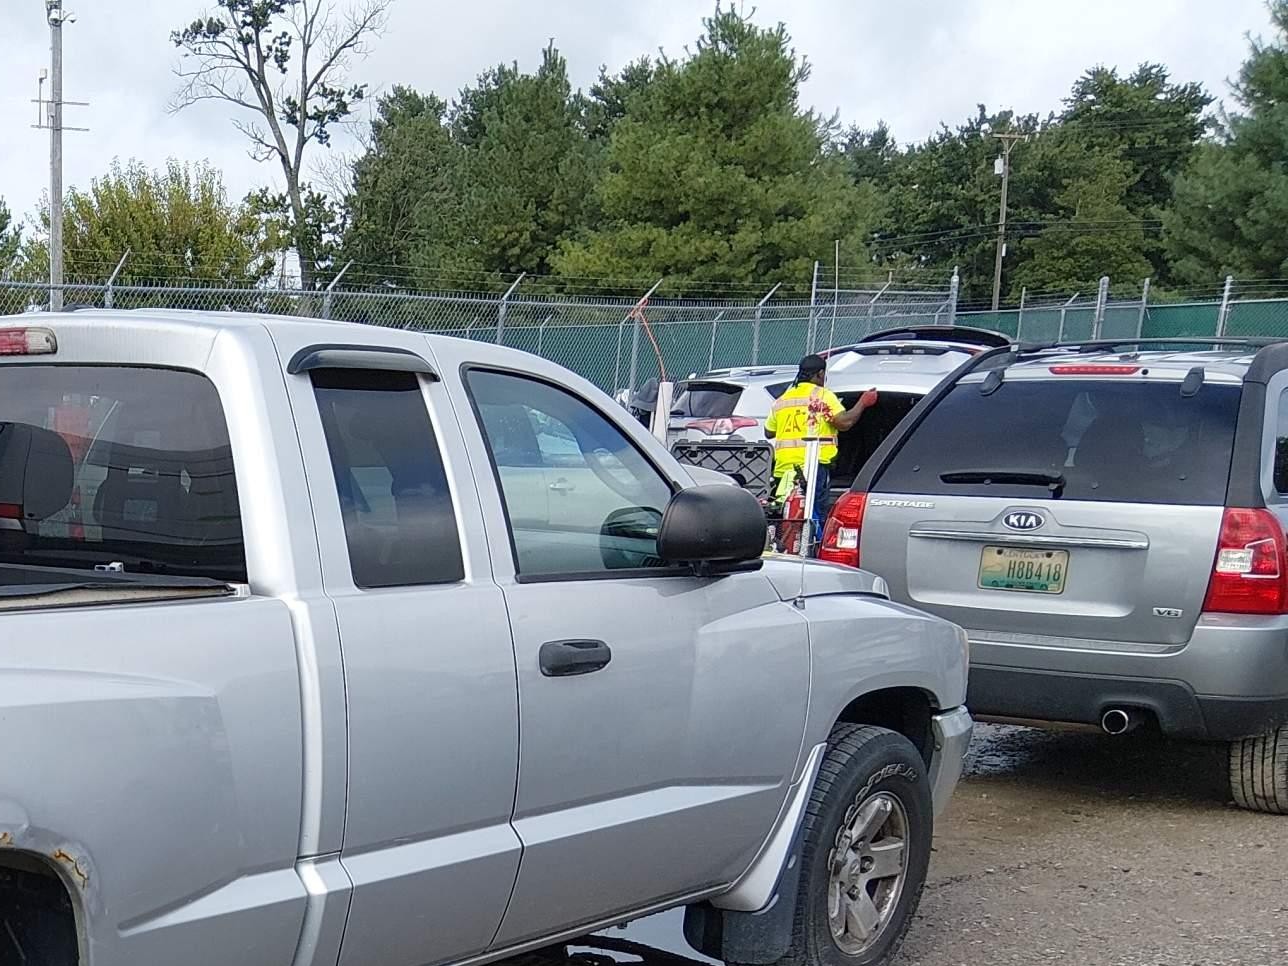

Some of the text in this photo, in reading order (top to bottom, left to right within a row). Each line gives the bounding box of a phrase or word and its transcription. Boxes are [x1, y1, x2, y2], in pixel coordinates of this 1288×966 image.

[870, 499, 936, 510] SPORTAGE
[1008, 514, 1037, 527] KIA
[1007, 560, 1062, 582] H8B418
[1154, 608, 1180, 618] V6
